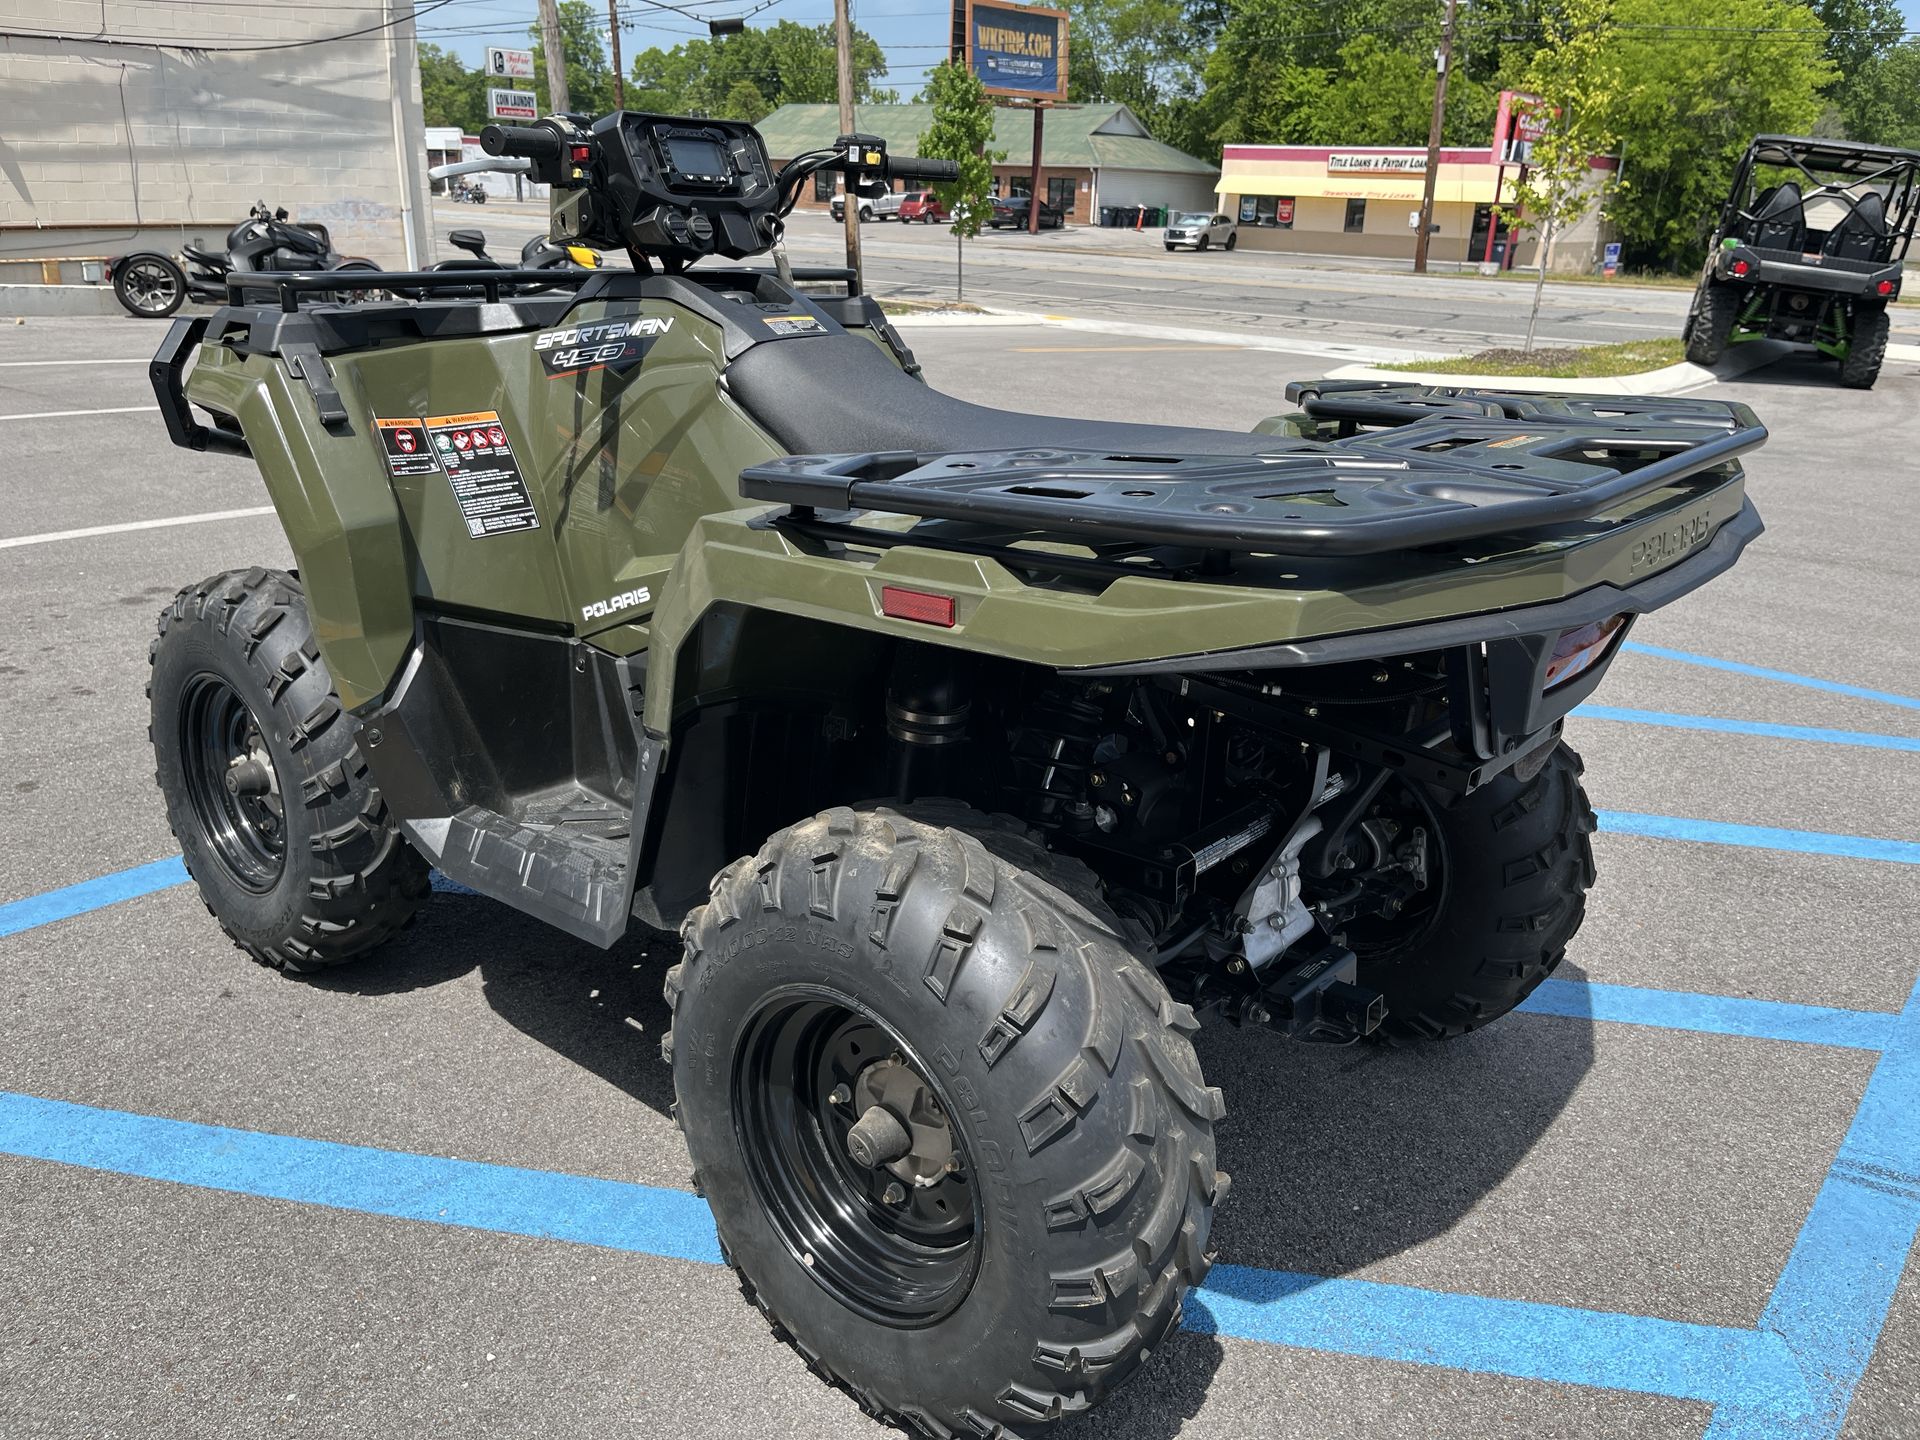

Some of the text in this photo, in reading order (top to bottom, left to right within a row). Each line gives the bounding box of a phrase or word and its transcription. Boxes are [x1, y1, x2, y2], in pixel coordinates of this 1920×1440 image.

[978, 25, 1052, 58] WKFIRM.COM
[496, 94, 534, 108] COIN LAUNDRY
[534, 317, 675, 351] SPORTSMAN
[552, 342, 626, 367] 450
[452, 416, 480, 424] WARNING
[1629, 511, 1711, 576] POLARIS
[582, 586, 651, 621] POLARIS
